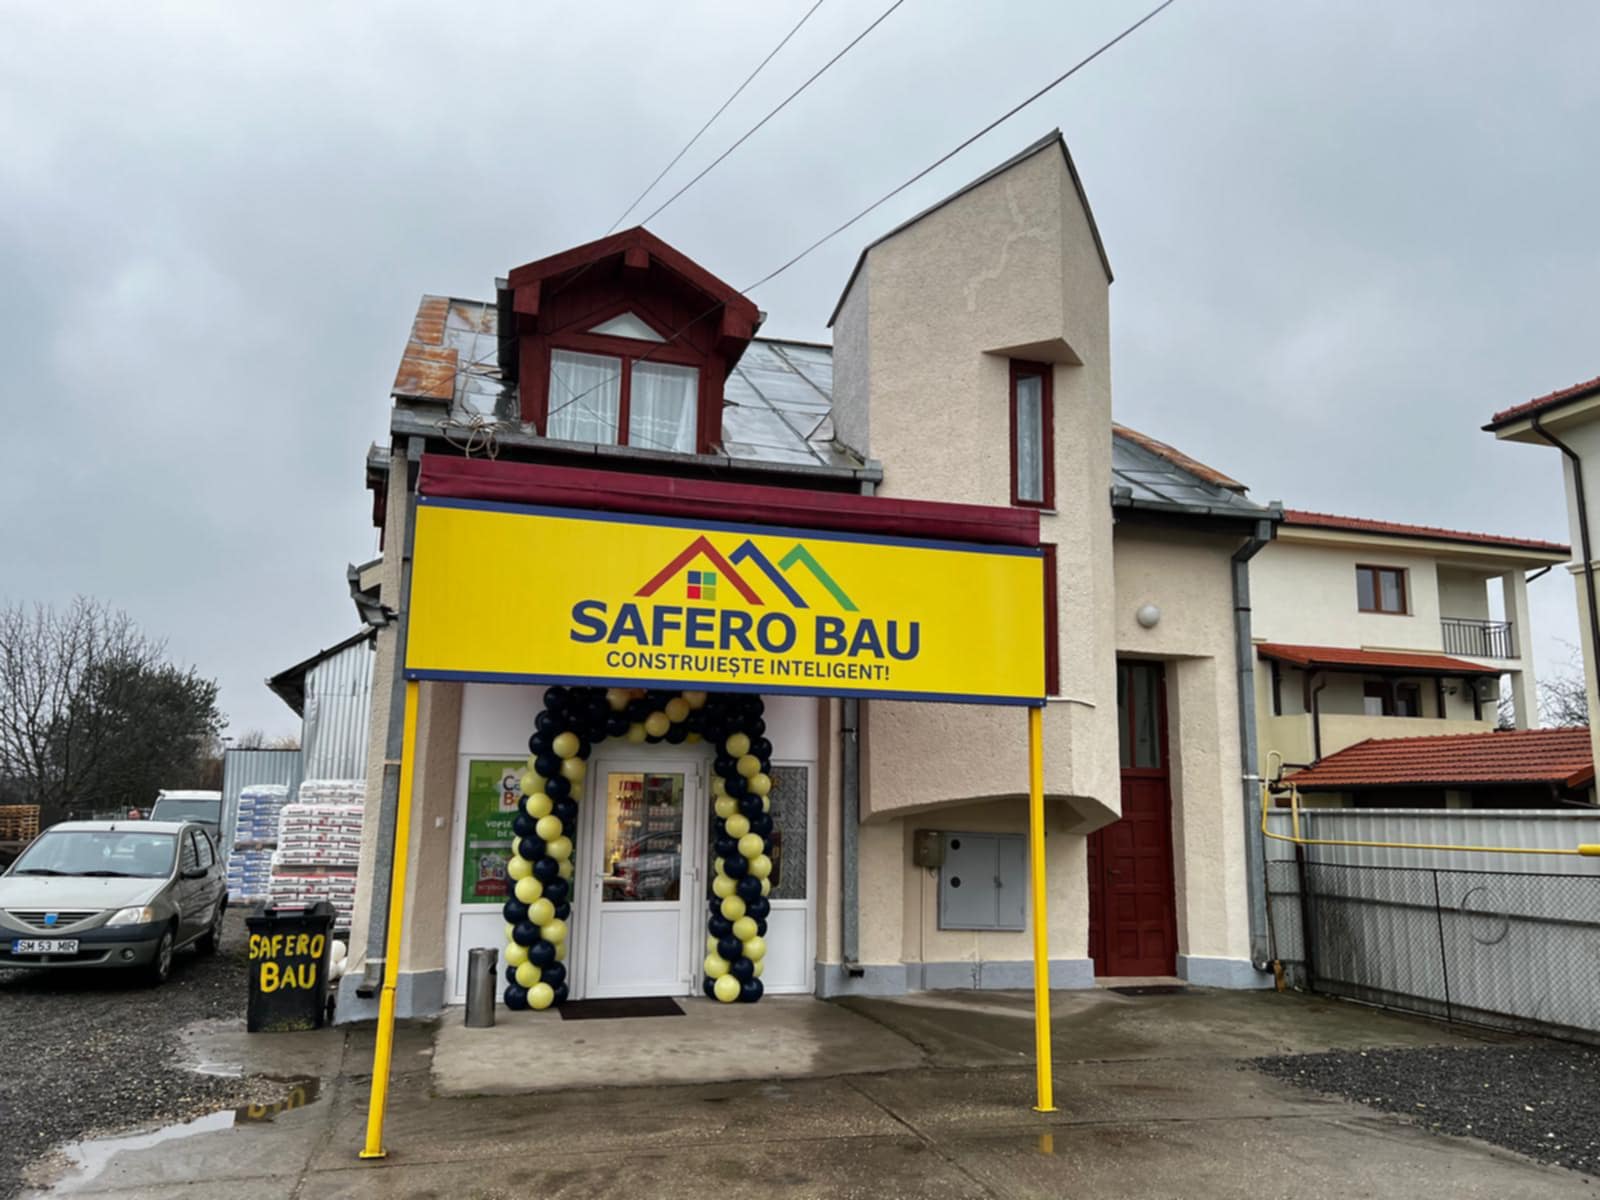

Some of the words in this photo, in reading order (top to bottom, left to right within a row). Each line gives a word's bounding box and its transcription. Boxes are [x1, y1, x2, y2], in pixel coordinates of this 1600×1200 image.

[570, 599, 797, 654] SAFERO
[814, 615, 920, 661] BAU
[606, 650, 764, 679] CONSTRUIEȘTE
[770, 659, 889, 681] INTELIGENT!
[20, 941, 35, 952] SM
[39, 940, 52, 951] 53
[249, 934, 325, 959] SAFERO
[260, 962, 316, 993] BAU
